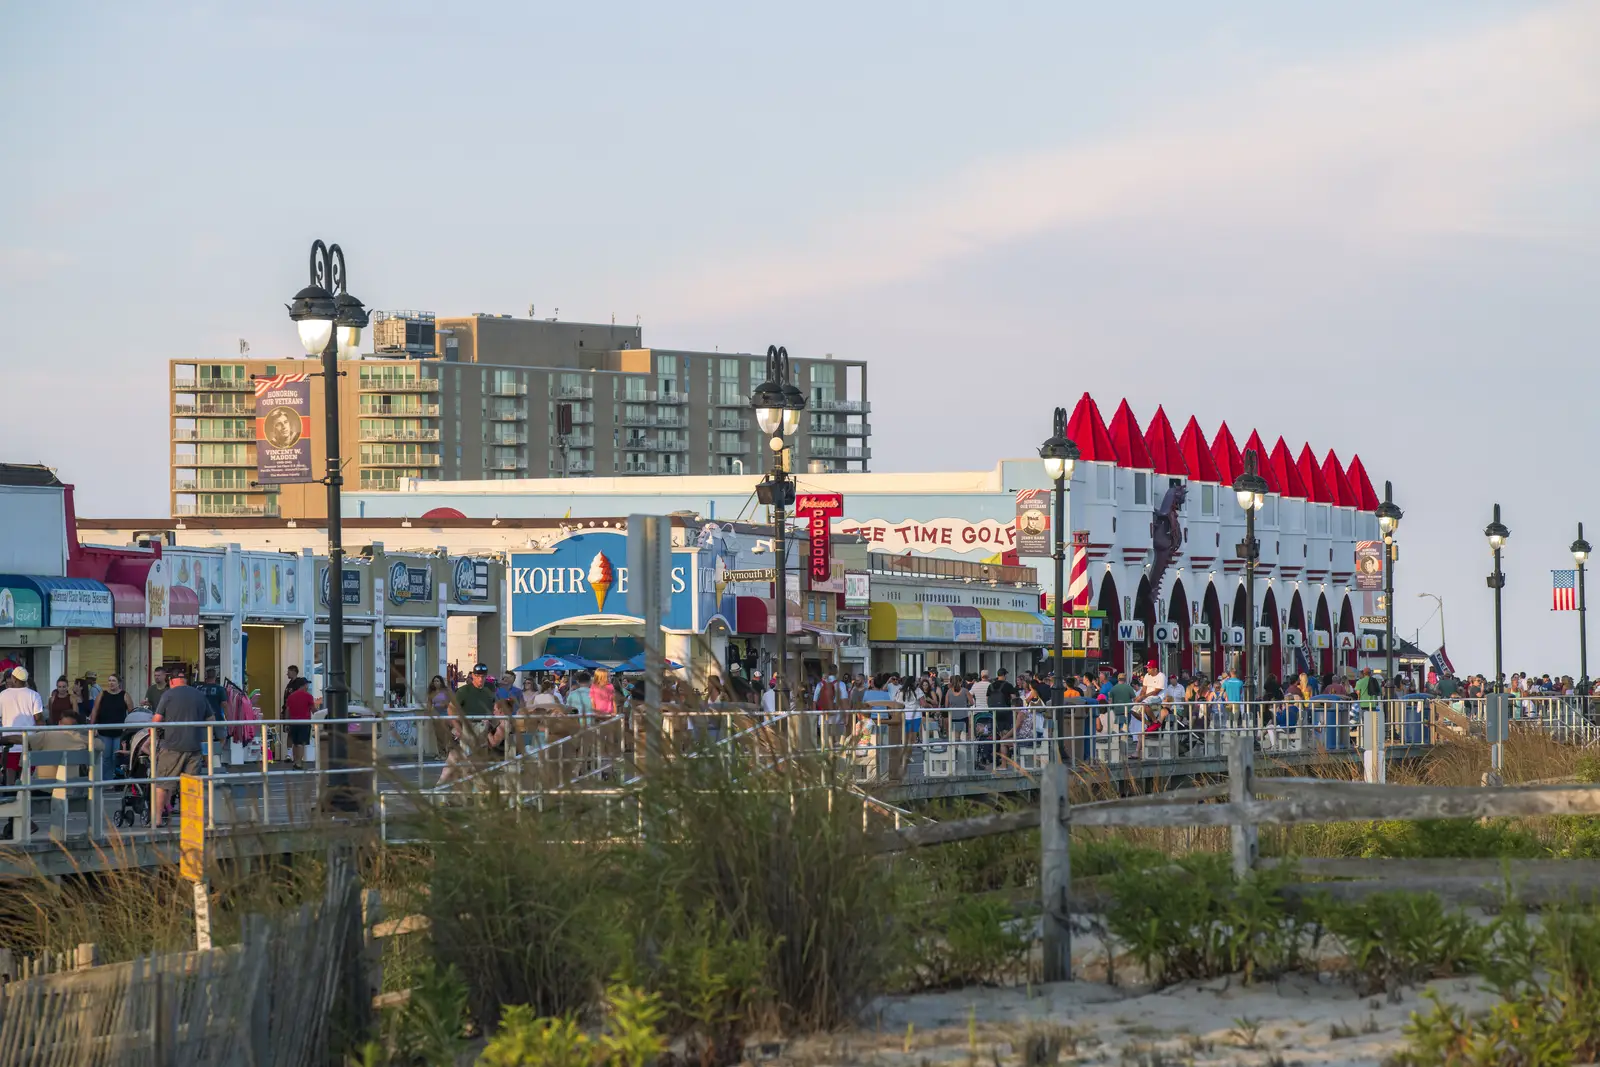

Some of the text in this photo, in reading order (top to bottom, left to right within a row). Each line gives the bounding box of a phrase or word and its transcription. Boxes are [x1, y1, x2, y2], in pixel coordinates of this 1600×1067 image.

[262, 398, 275, 406] OUR
[267, 390, 298, 398] HONORING
[813, 509, 825, 576] POPCORN
[842, 525, 1017, 546] TEE TIME GOLF
[512, 567, 686, 594] KOHR BS
[723, 570, 773, 582] Plymouth Pl
